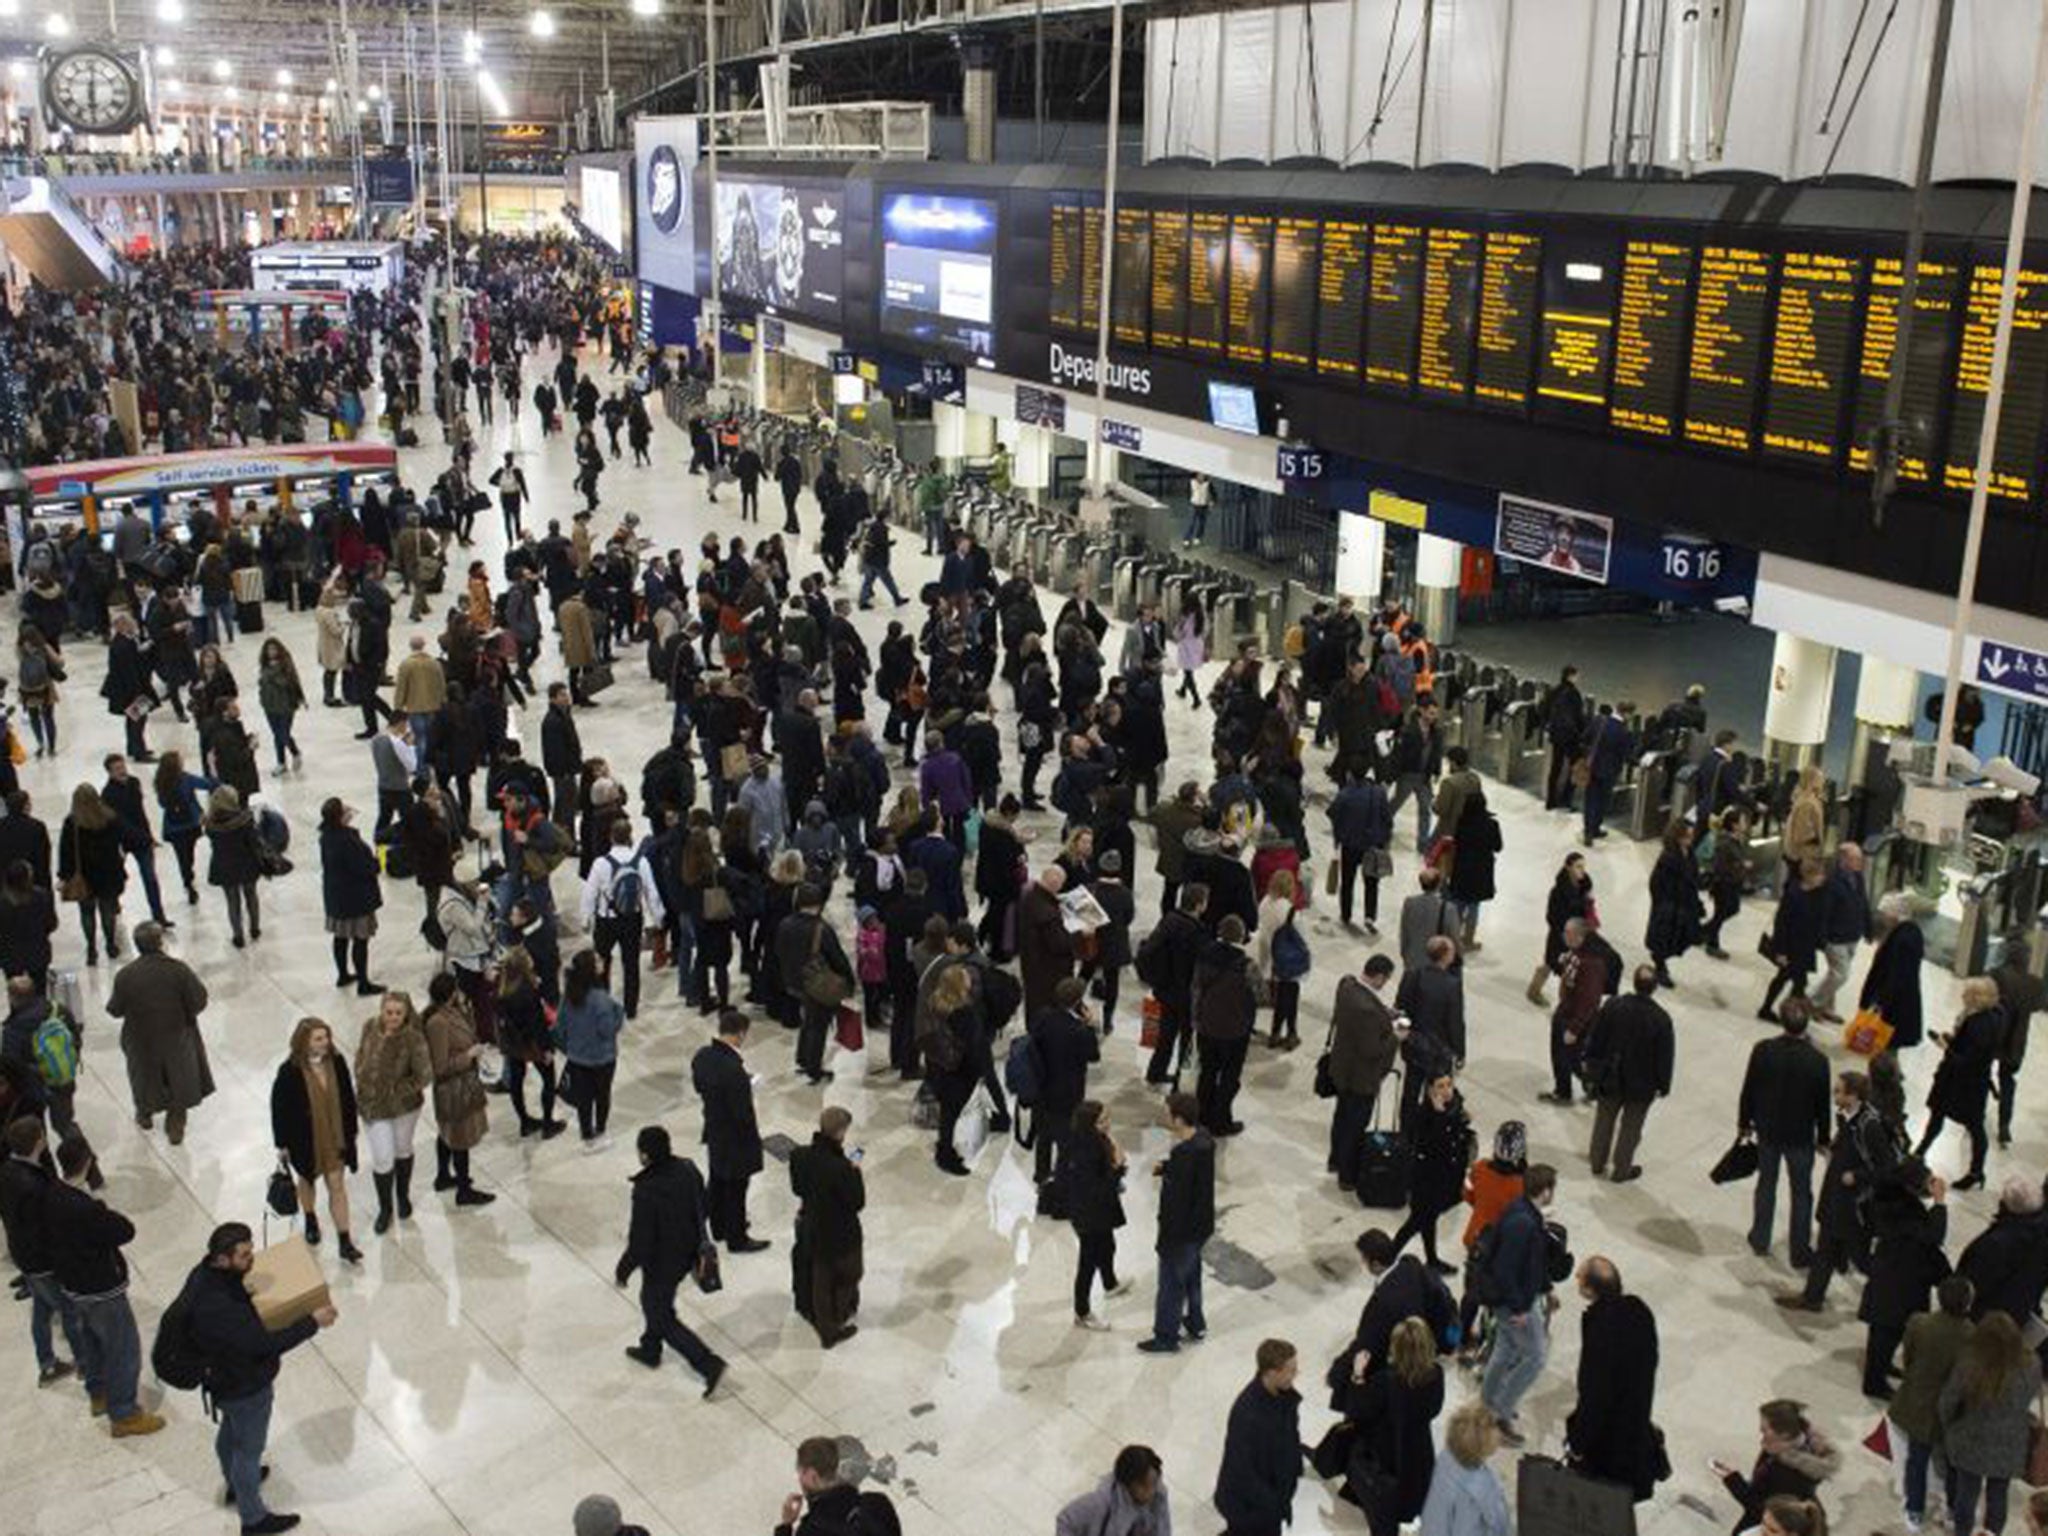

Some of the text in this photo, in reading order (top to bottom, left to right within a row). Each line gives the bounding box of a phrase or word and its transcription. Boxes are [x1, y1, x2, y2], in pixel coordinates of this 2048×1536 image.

[1050, 343, 1150, 395] Departures
[236, 462, 280, 476] tickets
[1280, 452, 1322, 477] 15 15
[1663, 546, 1721, 578] 16 16
